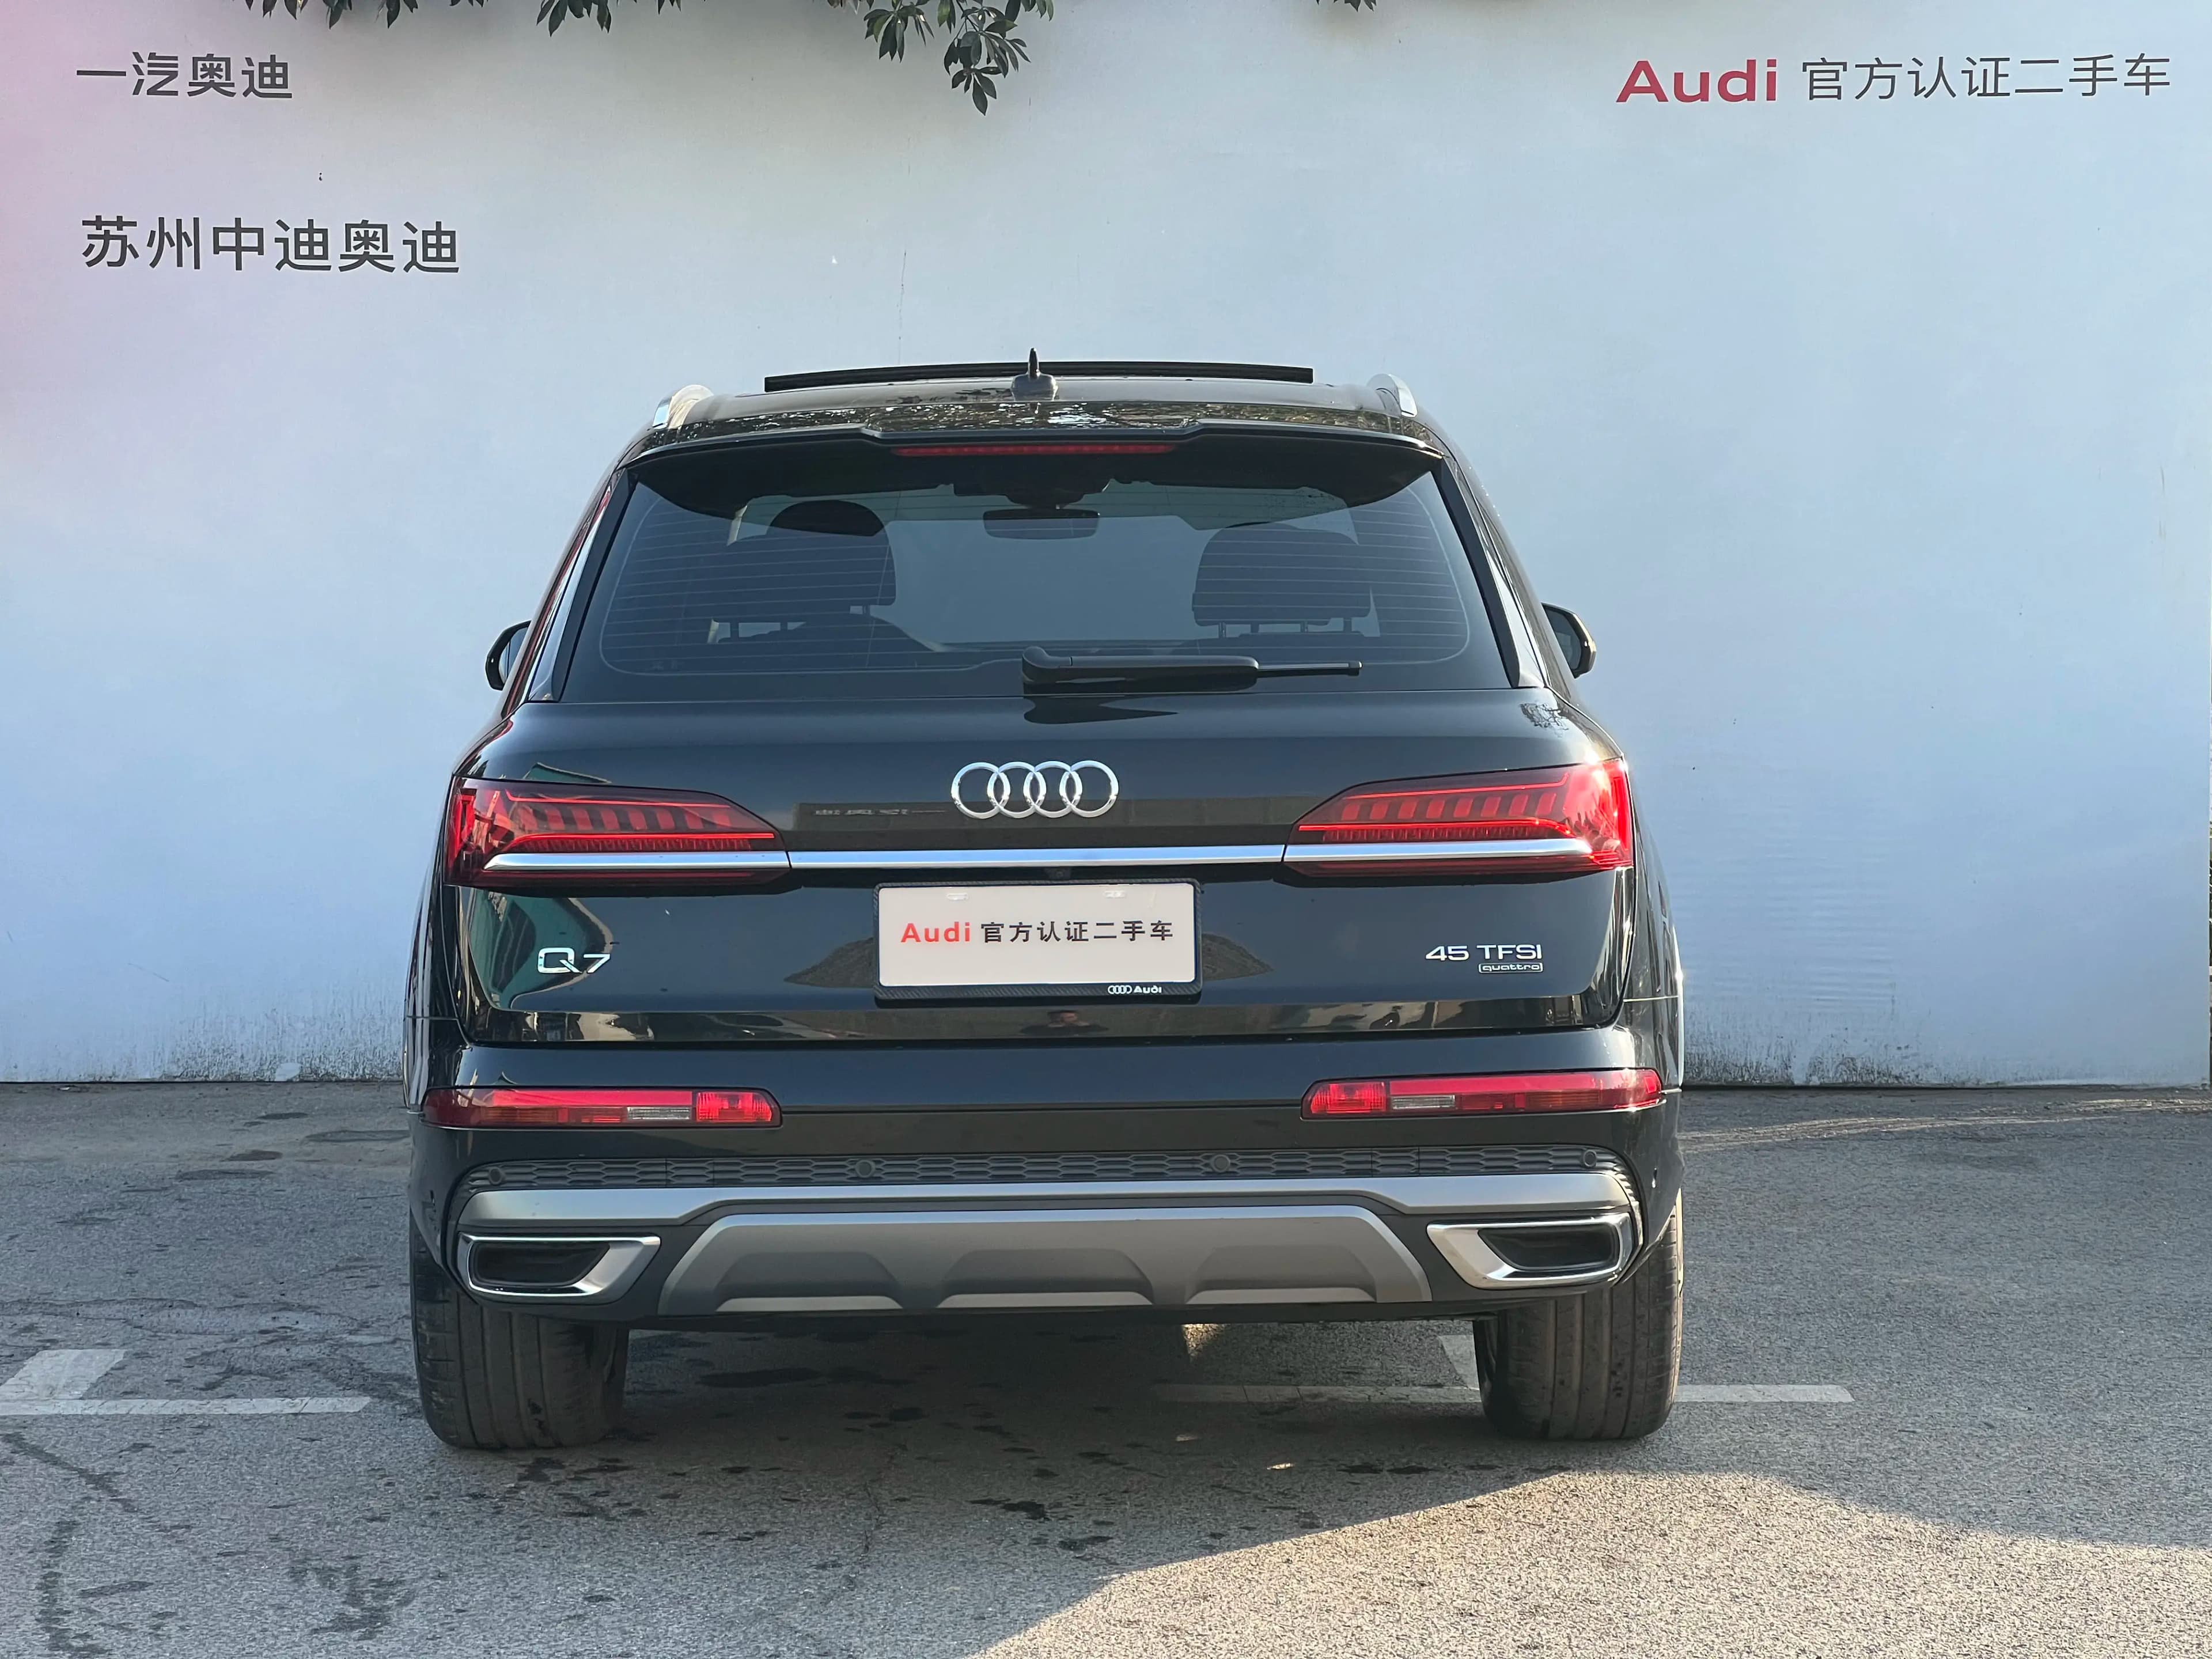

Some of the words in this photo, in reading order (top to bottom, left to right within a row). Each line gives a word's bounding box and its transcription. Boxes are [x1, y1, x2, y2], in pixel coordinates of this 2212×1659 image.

[77, 52, 293, 99] 一汽奥迪
[1616, 59, 1777, 103] Audi
[1802, 54, 2172, 100] 官方认证二手车
[82, 215, 459, 273] 苏州中迪奥迪
[901, 922, 970, 942] Audi
[981, 921, 1173, 942] 官方认证二手车
[537, 948, 610, 974] Q7
[1426, 946, 1469, 960] 45
[1476, 944, 1542, 960] TFSI
[1482, 964, 1540, 972] quattro
[1134, 985, 1162, 994] Audi
